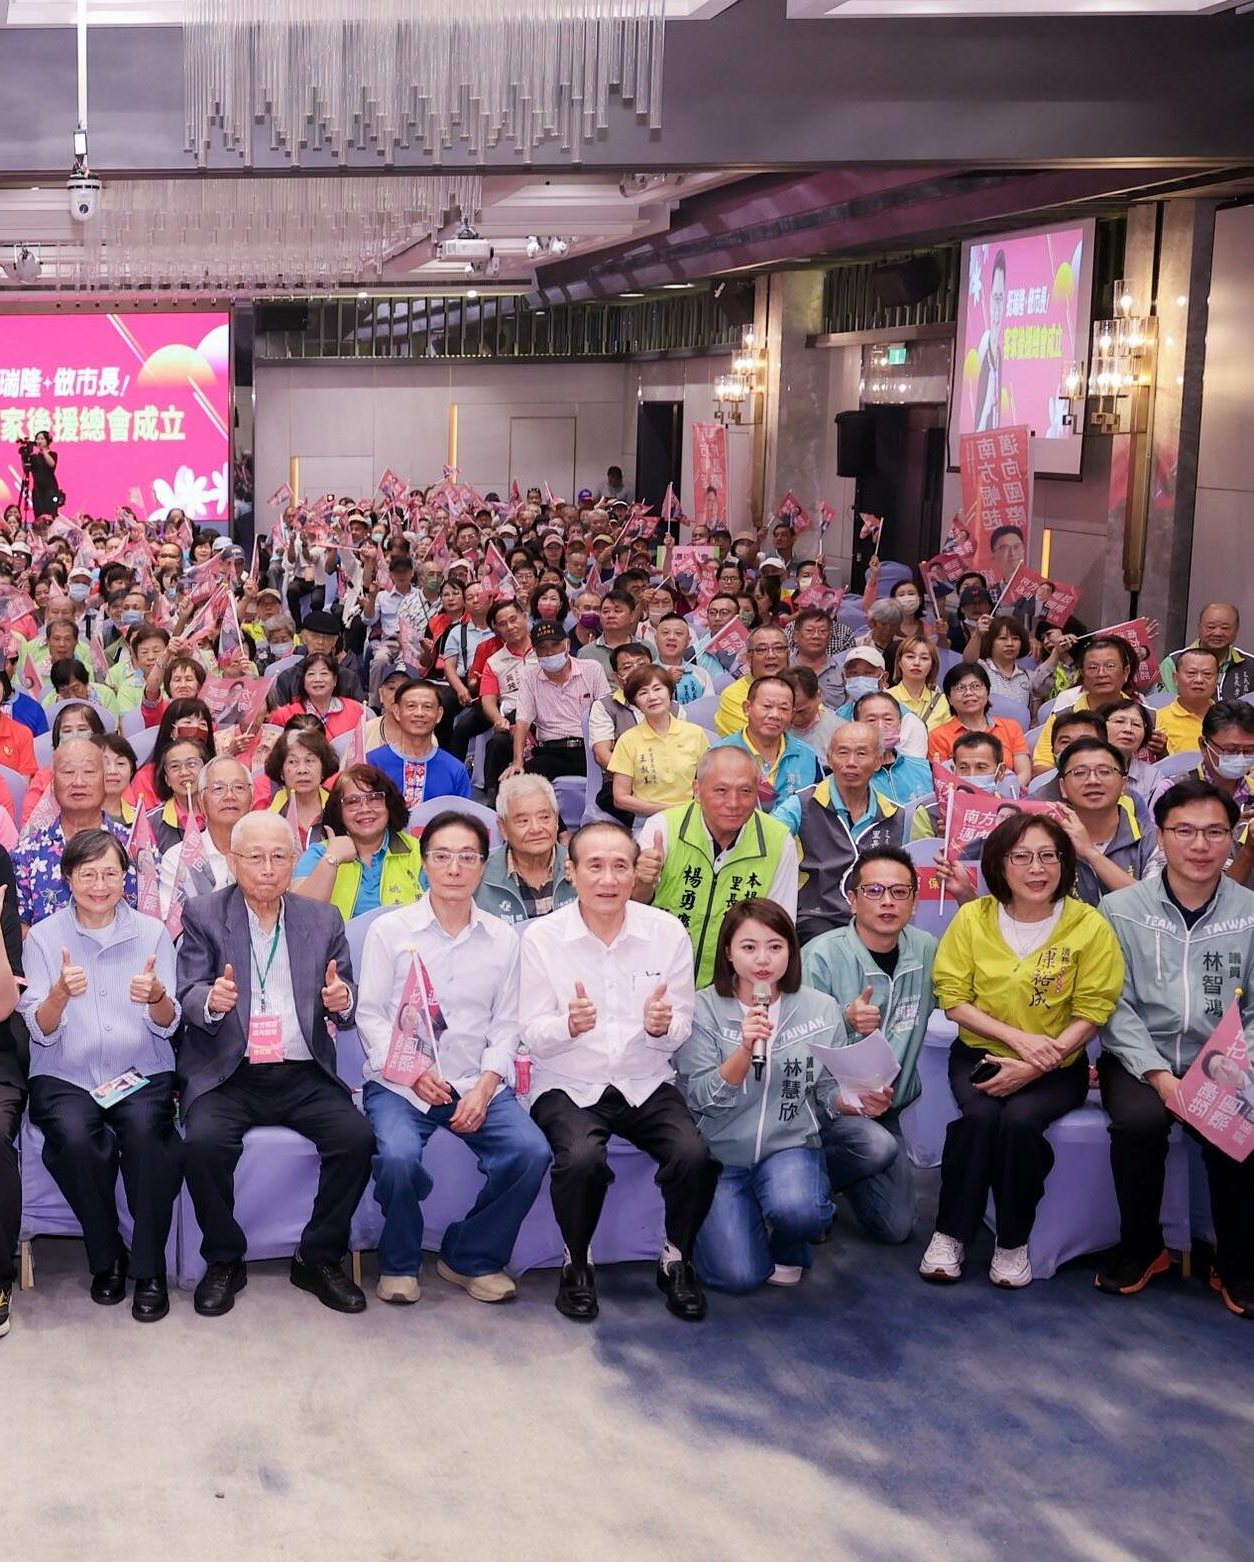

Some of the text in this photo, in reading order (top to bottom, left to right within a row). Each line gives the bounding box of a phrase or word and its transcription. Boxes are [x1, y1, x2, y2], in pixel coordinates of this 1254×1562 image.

[963, 809, 996, 827] 南方
[1144, 914, 1177, 934] TEAM
[1029, 948, 1058, 1009] 康裕成
[1228, 952, 1241, 979] 議員
[1202, 951, 1223, 1018] 林智鴻
[722, 1017, 825, 1041] TEA TAIWAN
[779, 1058, 802, 1122] 林慧欣
